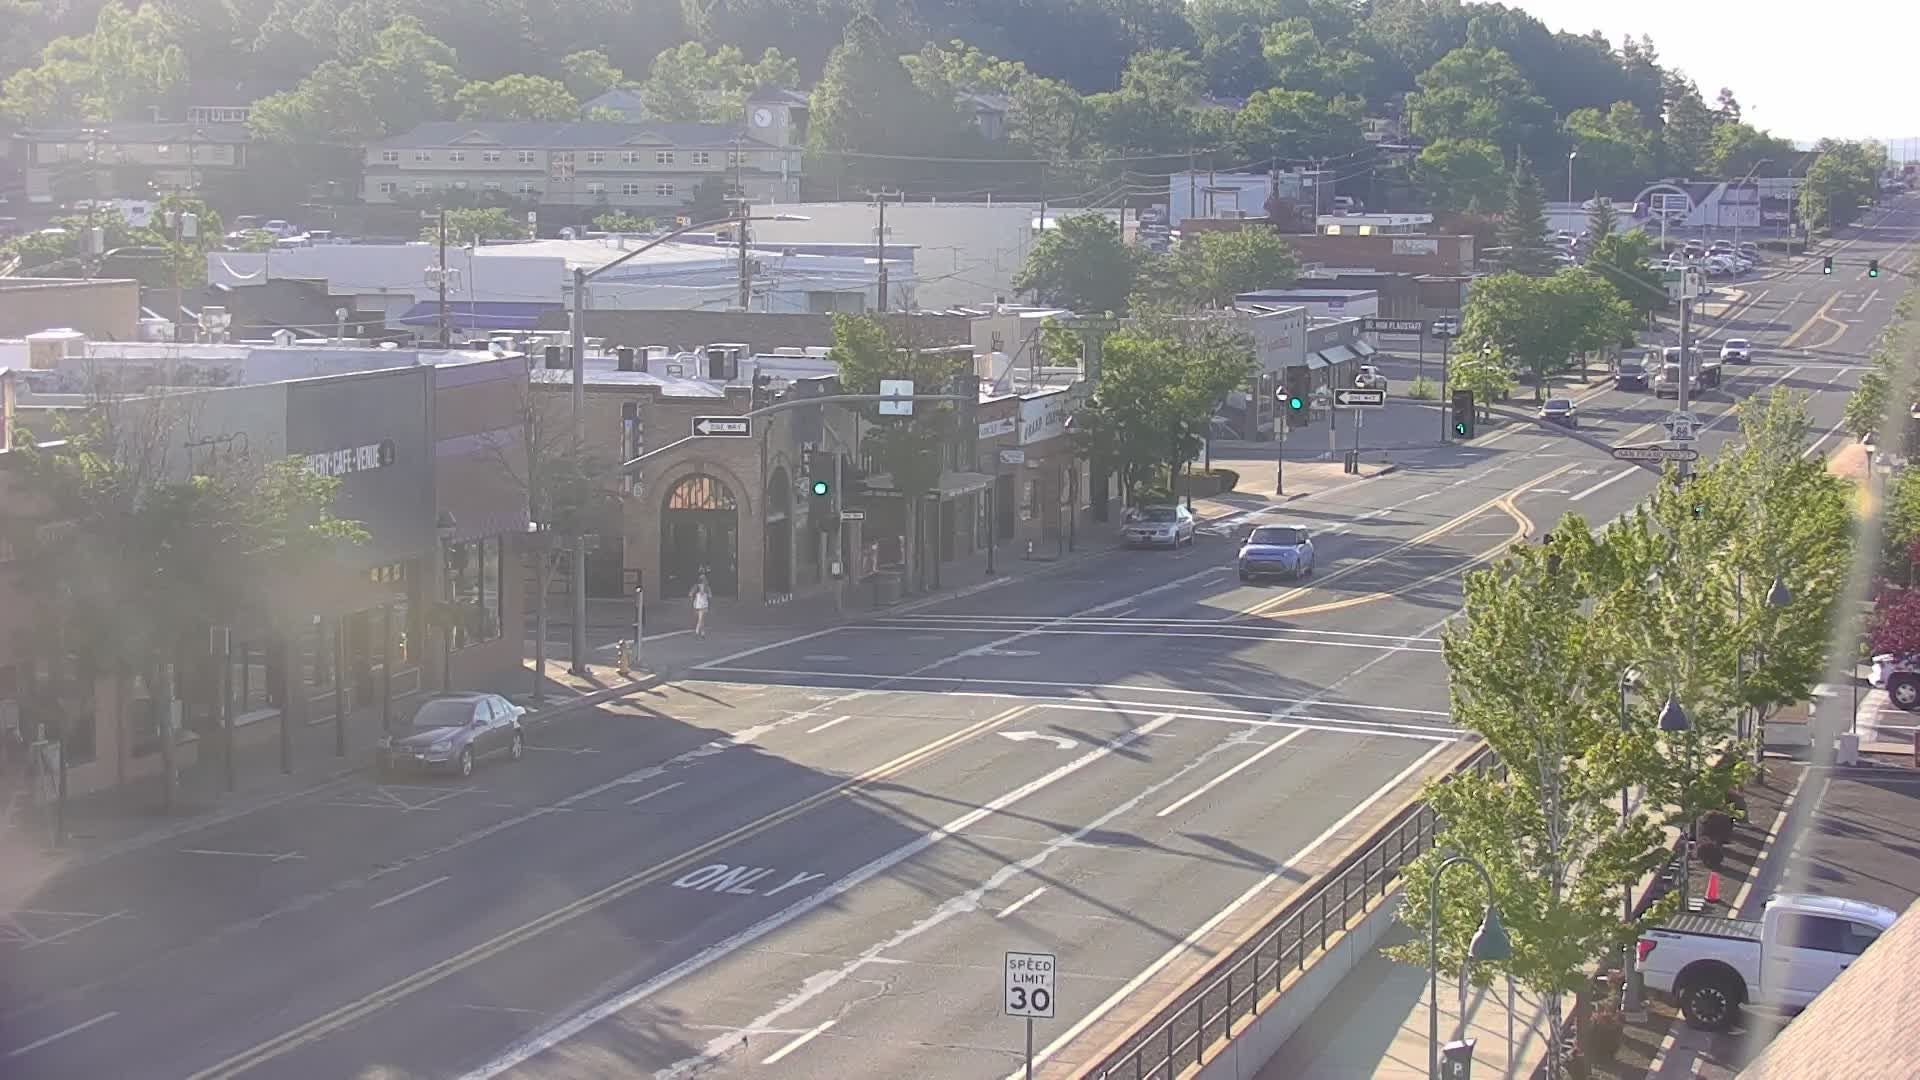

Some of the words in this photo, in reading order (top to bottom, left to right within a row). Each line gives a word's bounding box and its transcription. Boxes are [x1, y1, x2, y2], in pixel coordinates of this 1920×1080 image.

[672, 864, 825, 896] ONLY
[1009, 959, 1051, 971] SPEED
[1013, 973, 1045, 984] LIMIT
[1010, 986, 1050, 1011] 30
